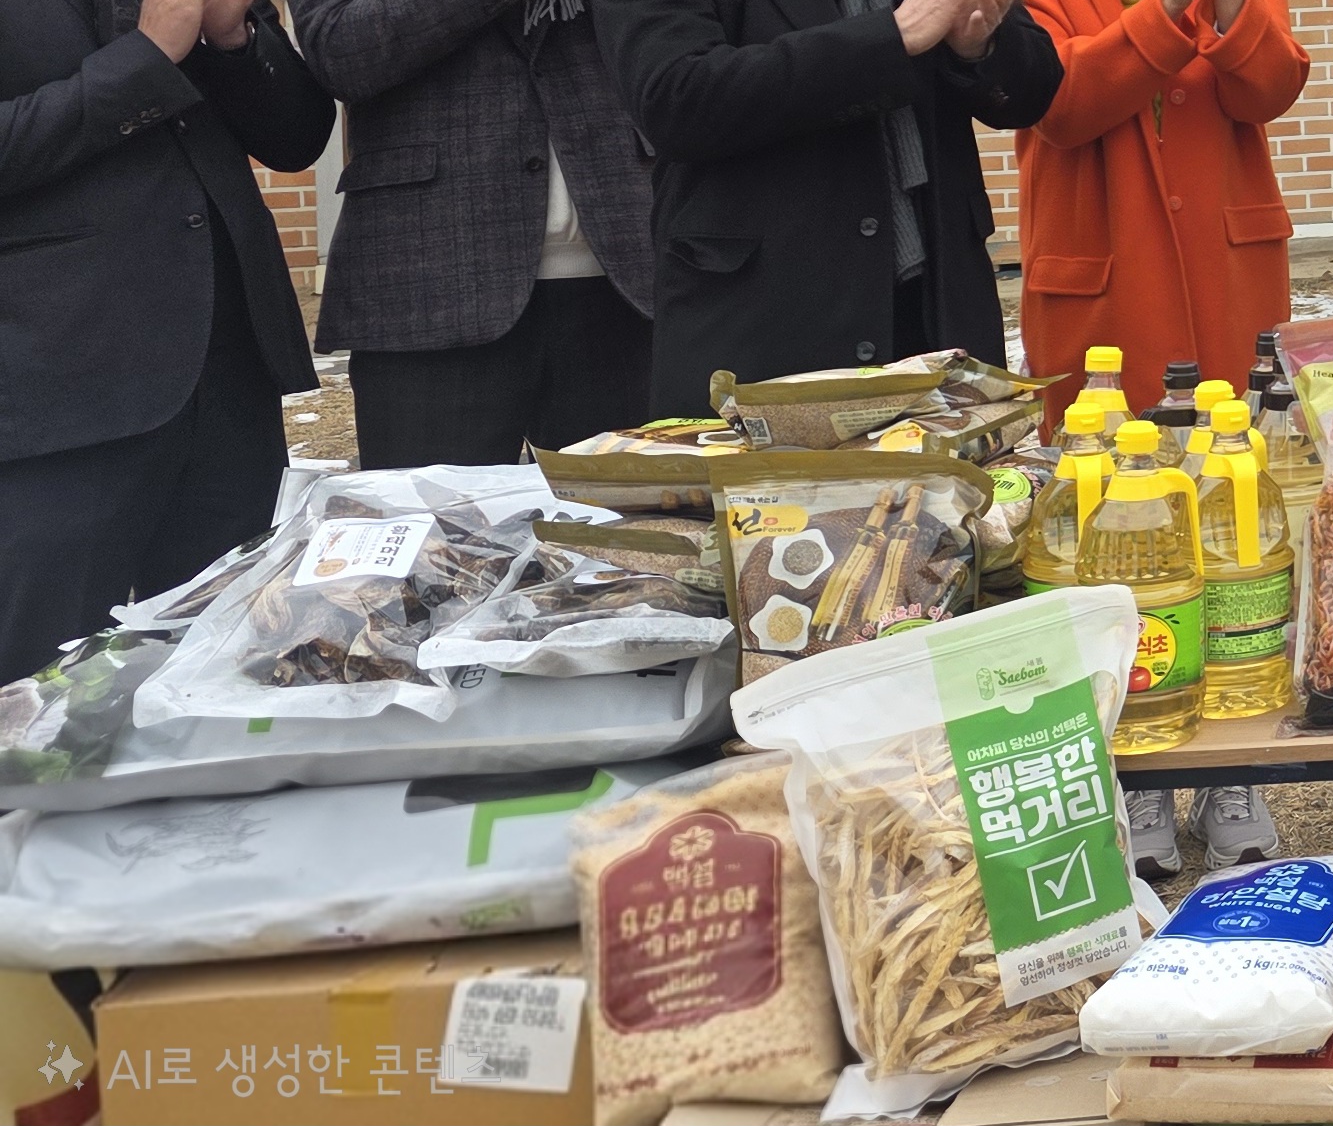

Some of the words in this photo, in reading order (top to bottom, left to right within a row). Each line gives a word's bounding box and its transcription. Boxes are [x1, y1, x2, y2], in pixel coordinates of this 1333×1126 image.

[762, 525, 796, 533] Forever
[998, 664, 1047, 685] Saebom
[967, 742, 1007, 761] 어차피
[1010, 729, 1049, 750] 당신의
[1052, 713, 1088, 739] 선택은
[969, 736, 1098, 808] 행복한
[980, 775, 1107, 844] 먹거리
[1201, 887, 1331, 910] 하얀설탕
[1255, 901, 1301, 914] SUGAR
[1018, 958, 1044, 974] 당신을
[1047, 951, 1064, 964] 위해
[1066, 940, 1092, 958] 행복한
[1095, 926, 1127, 945] 식재료를
[1020, 968, 1055, 986] 엄선하여
[1085, 940, 1130, 962] 담았습니다.
[1146, 963, 1189, 975] 하얀설탕
